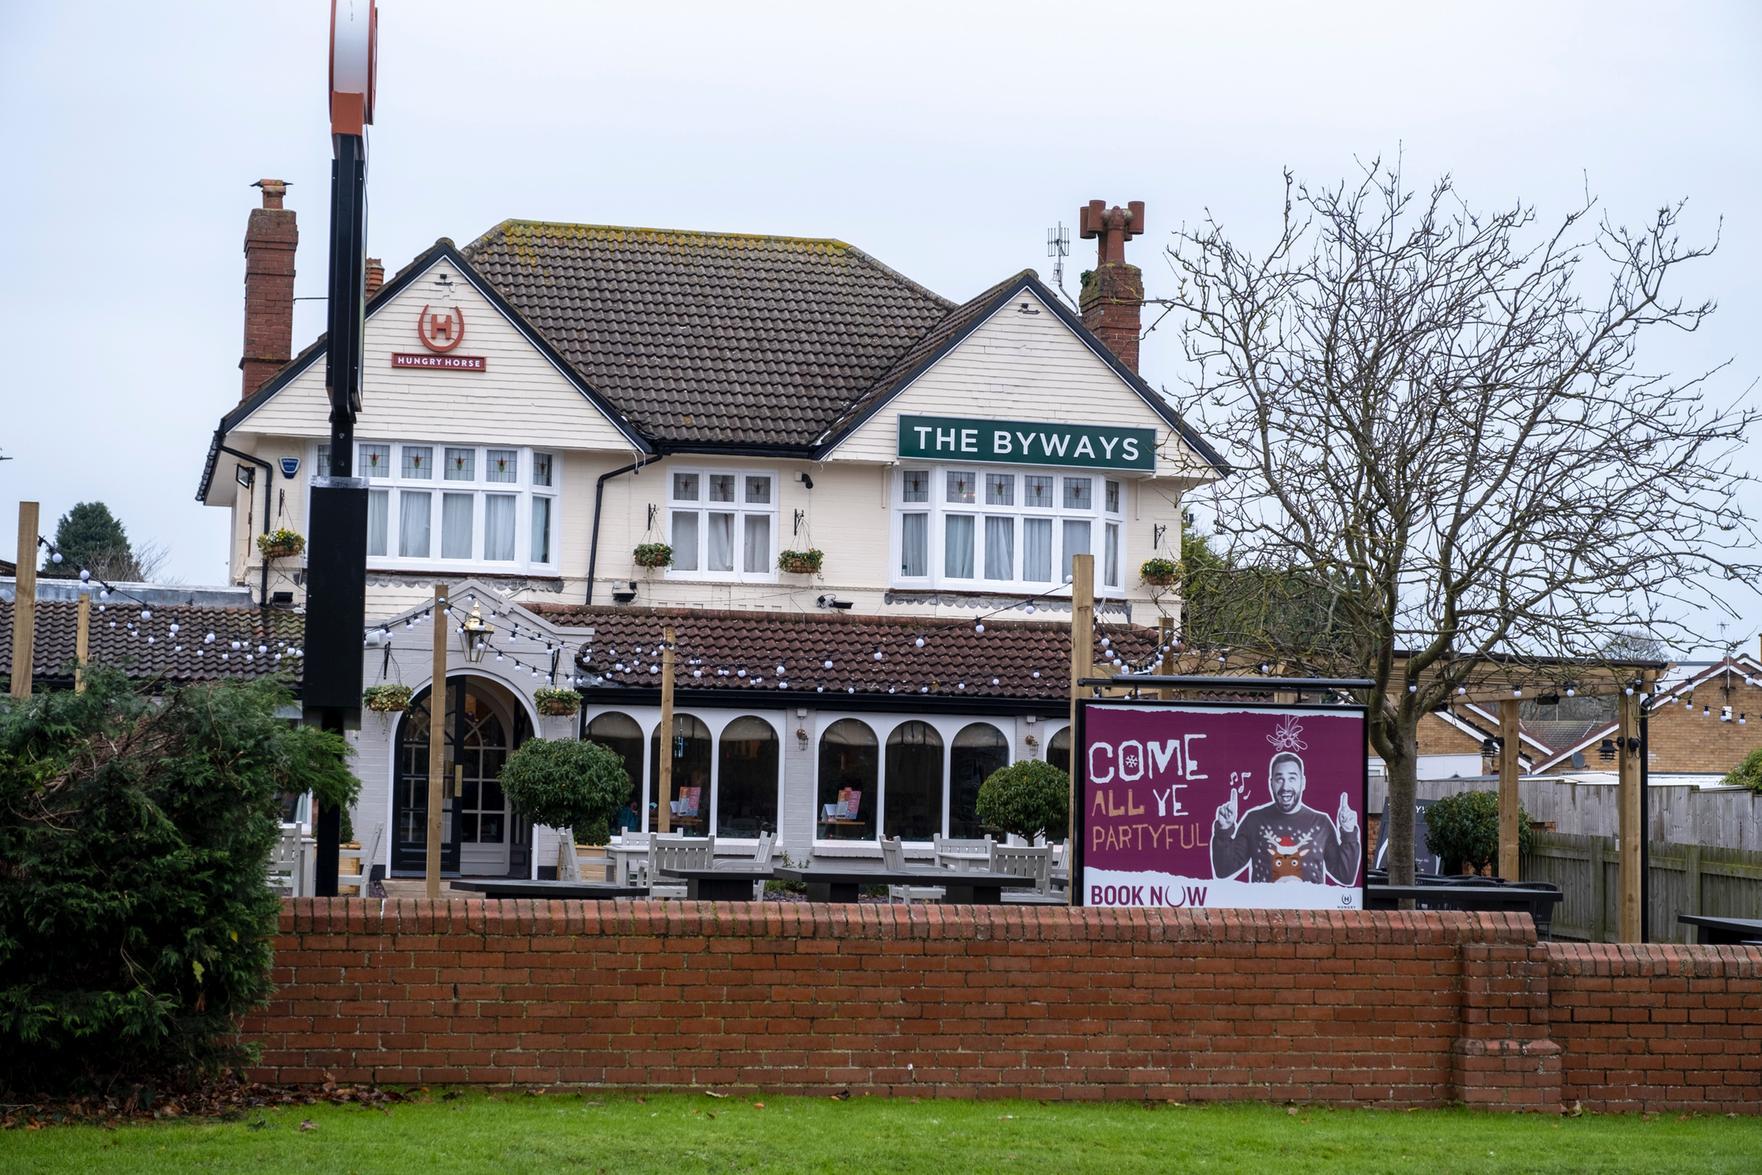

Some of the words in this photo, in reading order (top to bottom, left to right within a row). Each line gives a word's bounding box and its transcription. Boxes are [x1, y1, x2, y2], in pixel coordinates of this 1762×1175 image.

[431, 314, 452, 339] H
[398, 357, 442, 366] HUNGRY
[444, 358, 480, 367] HORSE
[913, 426, 978, 452] THE
[993, 430, 1139, 461] BYWAYS
[1088, 733, 1208, 784] COME
[1091, 789, 1145, 817] ALL
[1153, 784, 1189, 817] YE
[1092, 823, 1208, 852] PARTYFUL
[1091, 885, 1144, 906] BOOK
[1150, 884, 1208, 908] NOW
